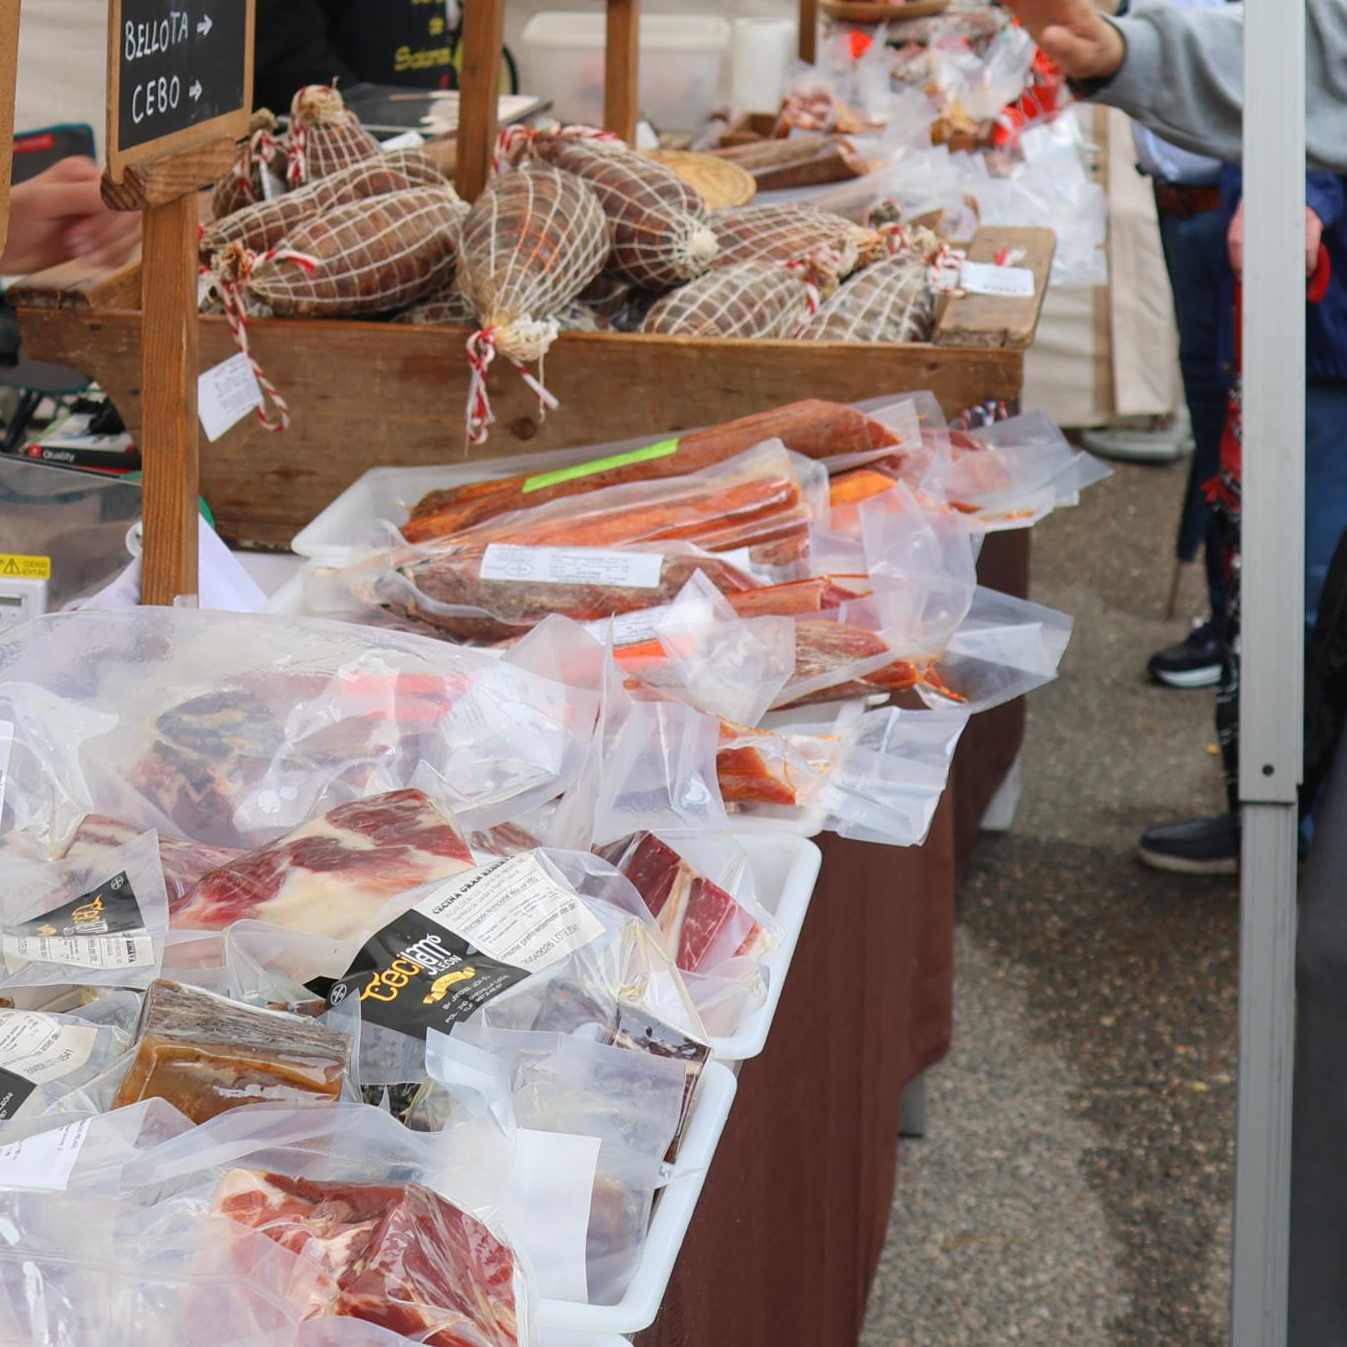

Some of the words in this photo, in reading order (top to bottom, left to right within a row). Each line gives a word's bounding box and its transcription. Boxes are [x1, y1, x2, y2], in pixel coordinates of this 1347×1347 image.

[125, 11, 188, 61] BELLOTA
[132, 75, 180, 124] CEBO
[42, 449, 76, 462] Quality
